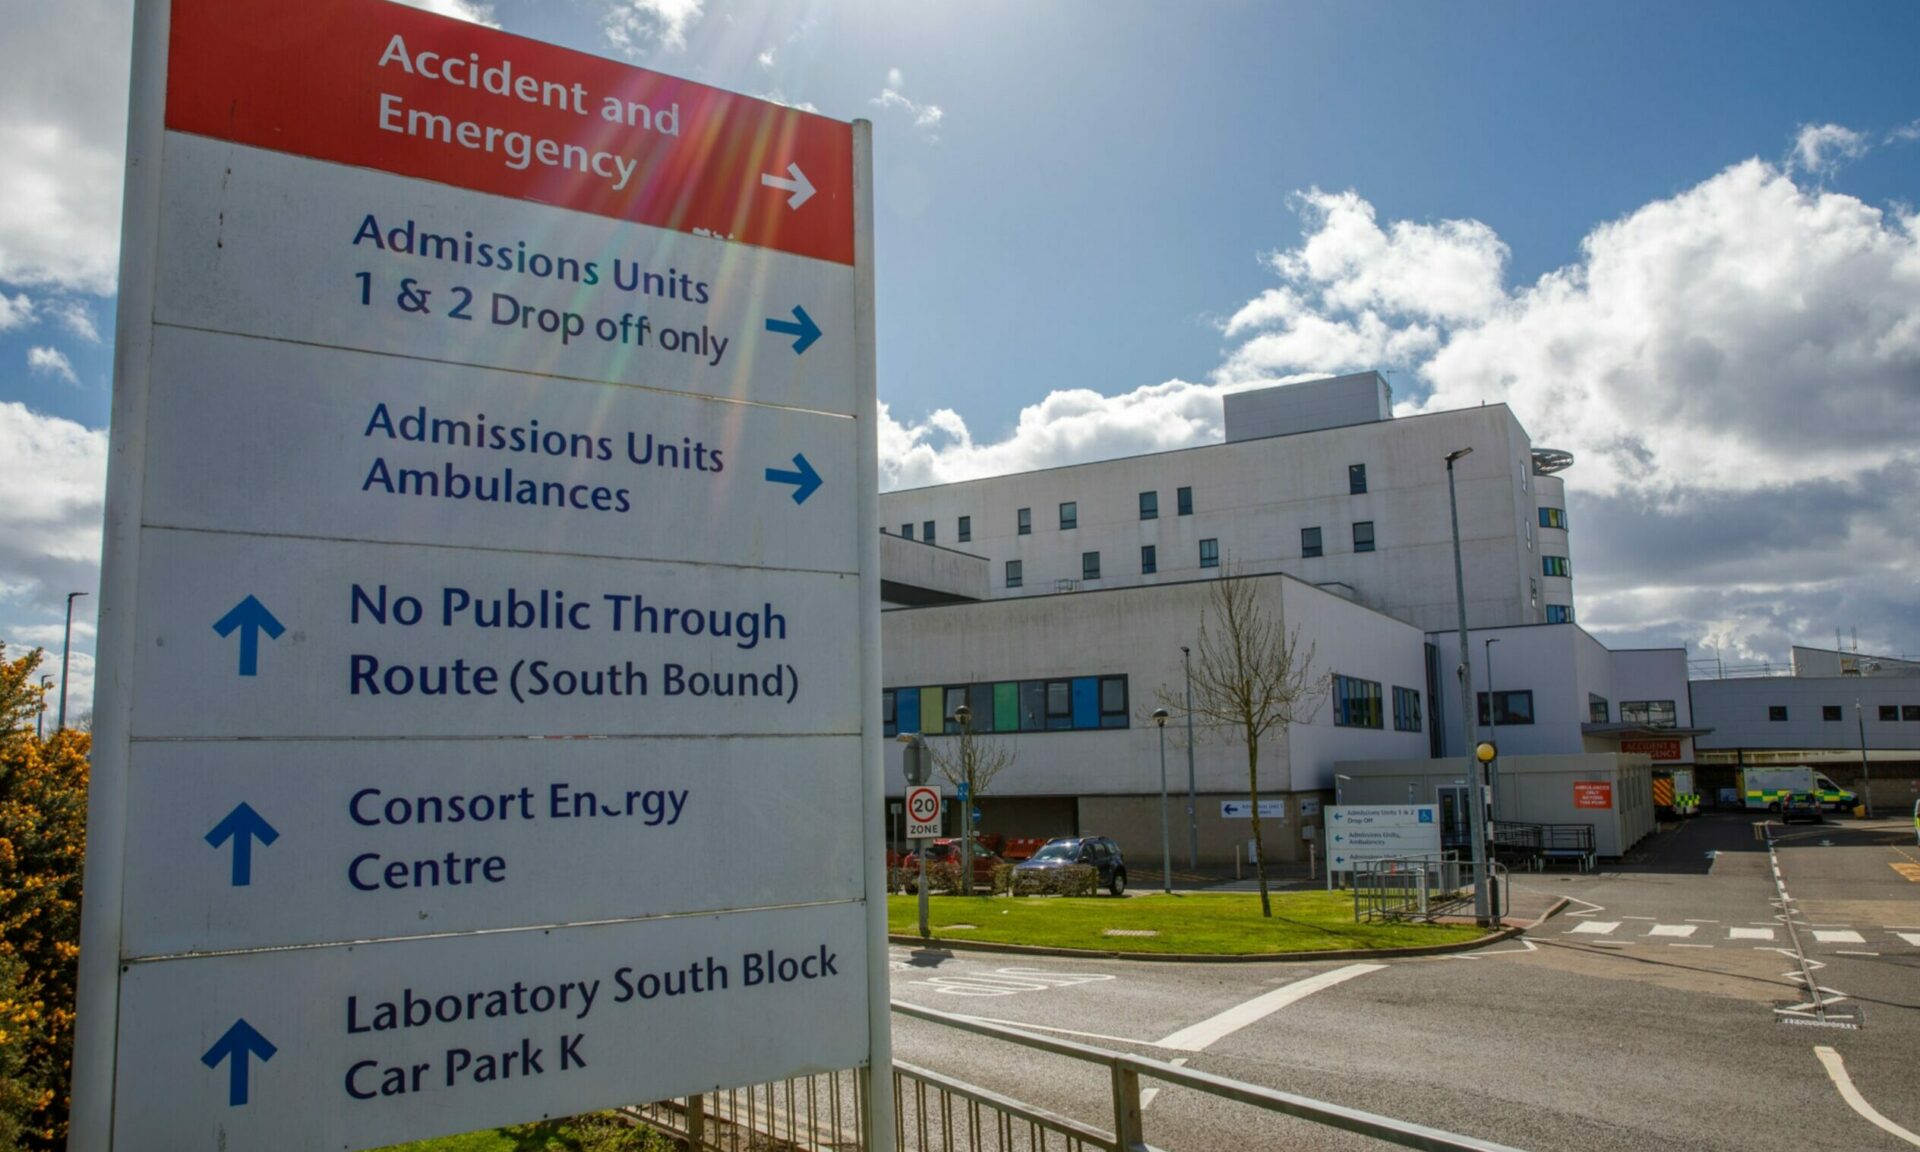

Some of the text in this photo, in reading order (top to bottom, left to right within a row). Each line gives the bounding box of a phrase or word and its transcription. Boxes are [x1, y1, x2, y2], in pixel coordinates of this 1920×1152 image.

[379, 33, 678, 136] Accident and
[378, 94, 638, 191] Emergency
[352, 214, 708, 304] Admissions Units
[356, 272, 728, 366] 1 & 2 Drop off only
[364, 403, 723, 472] Admissions Units
[362, 458, 629, 512] Ambulances
[351, 584, 785, 649] No Public Through
[351, 655, 798, 703] Route (South Bound)
[349, 788, 534, 826] Consort
[910, 824, 938, 834] ZONE
[914, 798, 934, 812] 20
[1347, 817, 1362, 825] Drop
[348, 852, 505, 891] Centre
[347, 945, 837, 1034] Laboratory South Block
[345, 1034, 586, 1099] Car Park K
